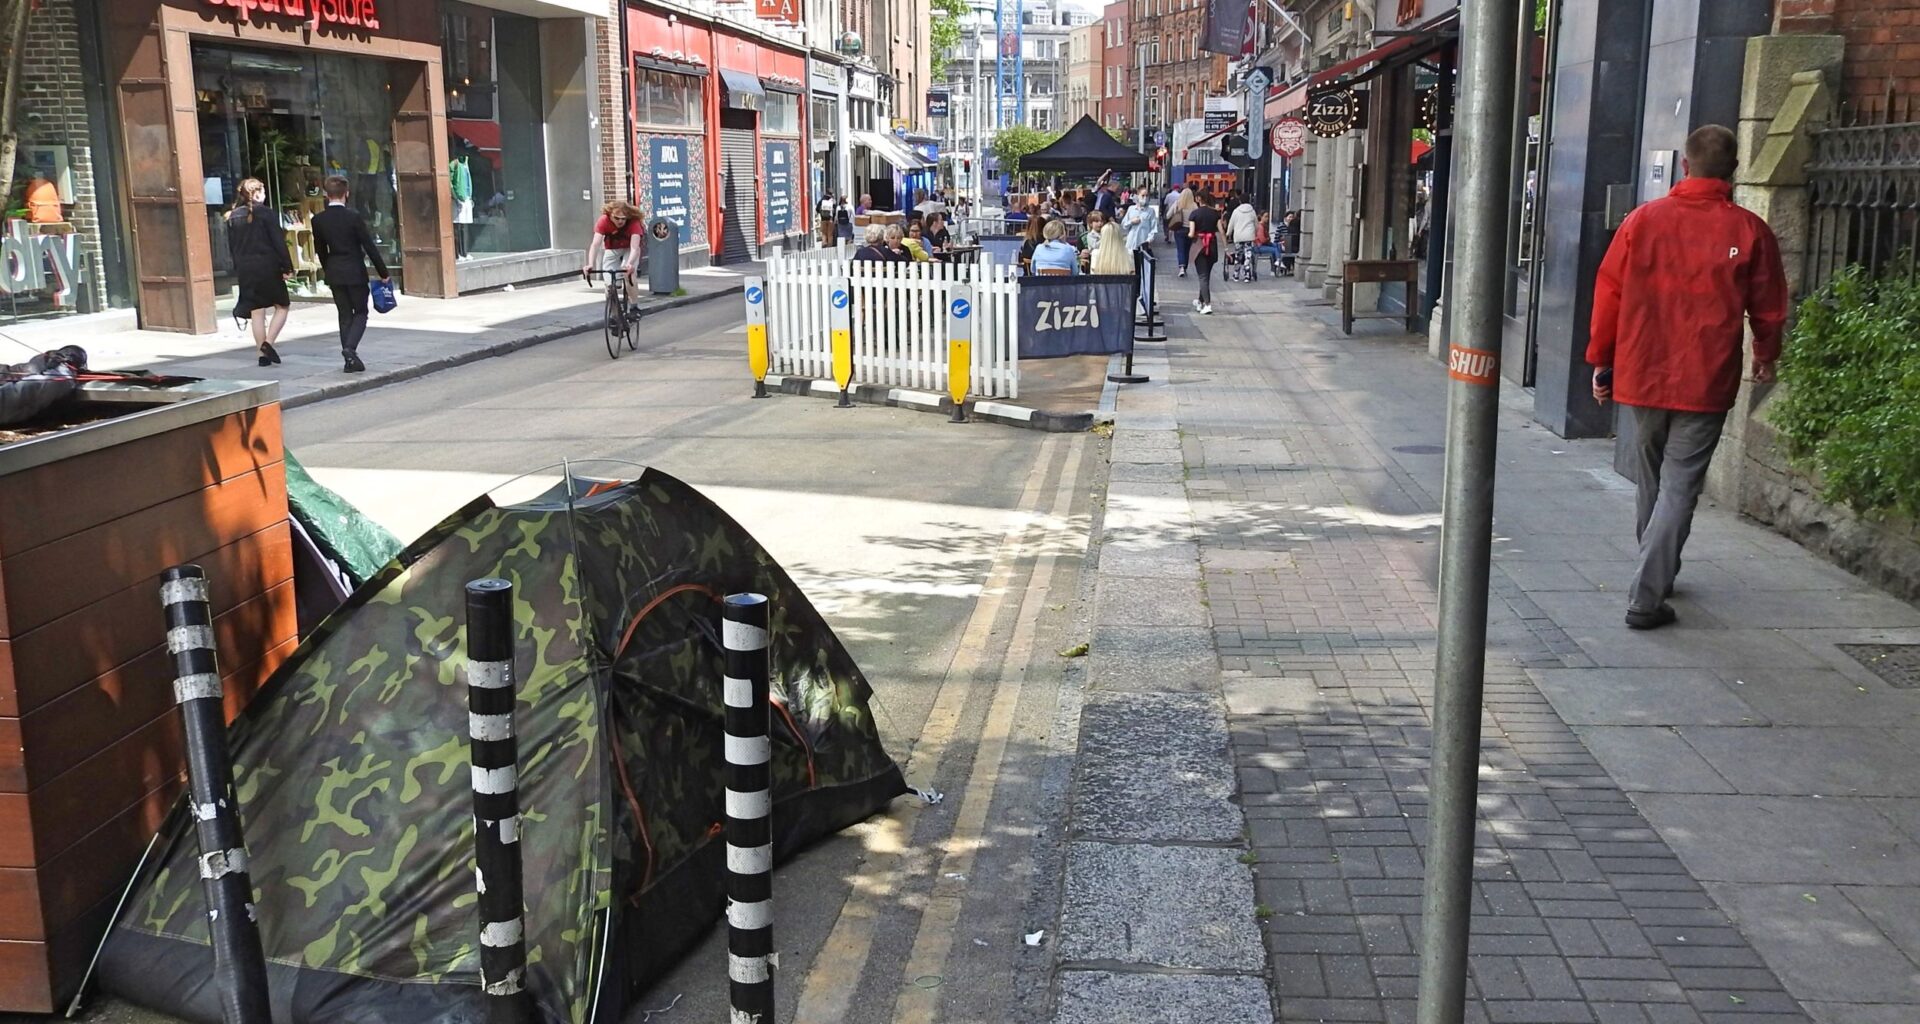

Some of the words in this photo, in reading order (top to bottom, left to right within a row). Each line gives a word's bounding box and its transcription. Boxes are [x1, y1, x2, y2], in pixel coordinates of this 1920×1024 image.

[1311, 103, 1349, 116] Zizzi
[1314, 120, 1345, 132] ITALIAN
[1729, 246, 1739, 259] P
[1034, 299, 1100, 332] Zizzi
[1450, 348, 1496, 378] SHUP
